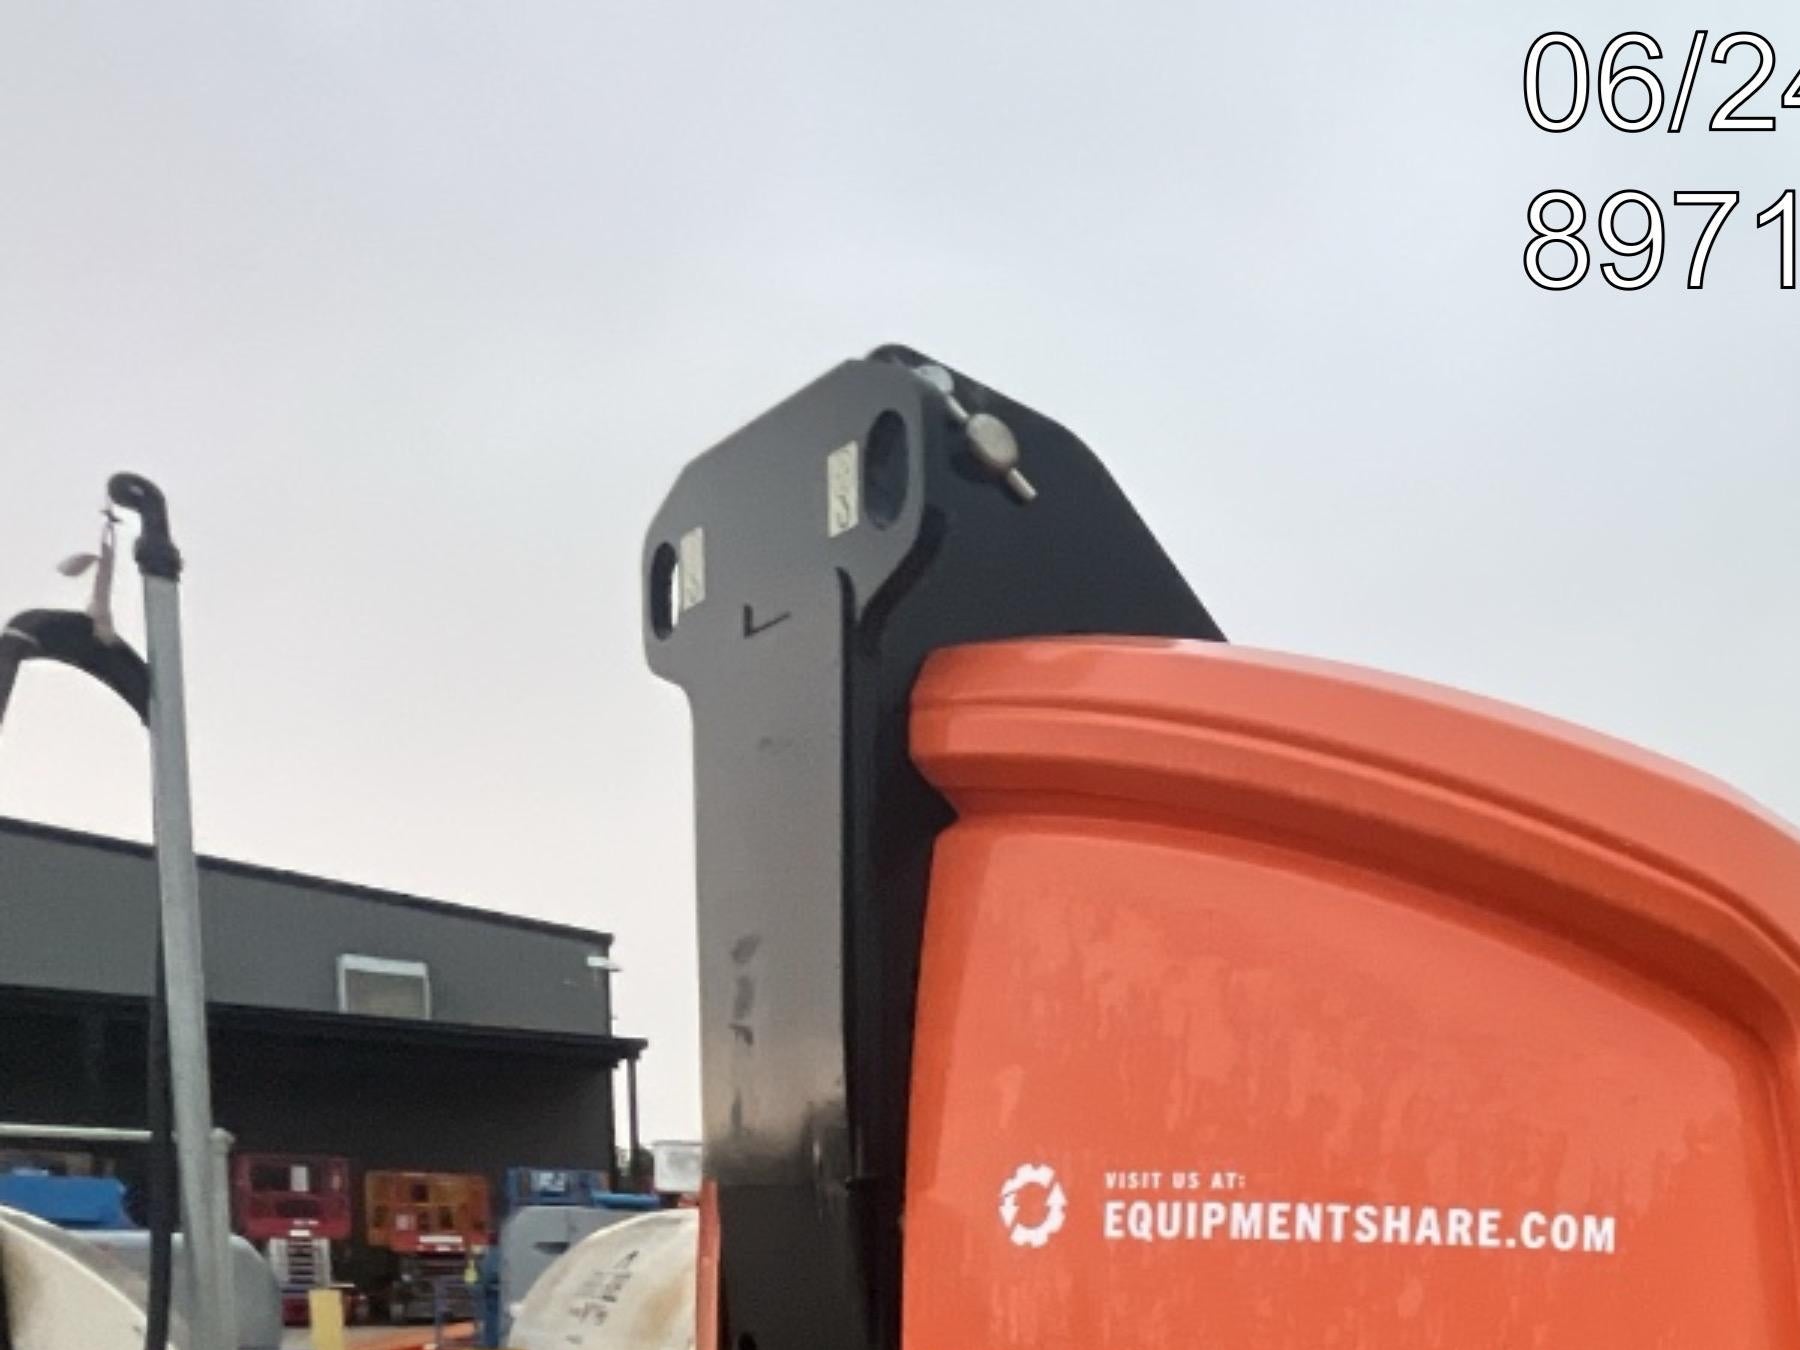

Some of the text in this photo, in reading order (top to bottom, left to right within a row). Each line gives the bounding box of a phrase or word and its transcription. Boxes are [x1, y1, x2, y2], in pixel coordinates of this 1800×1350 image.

[1104, 1171, 1246, 1190] VISIT US AT:
[1103, 1200, 1617, 1254] EQUIPMENTSHARE.COM
